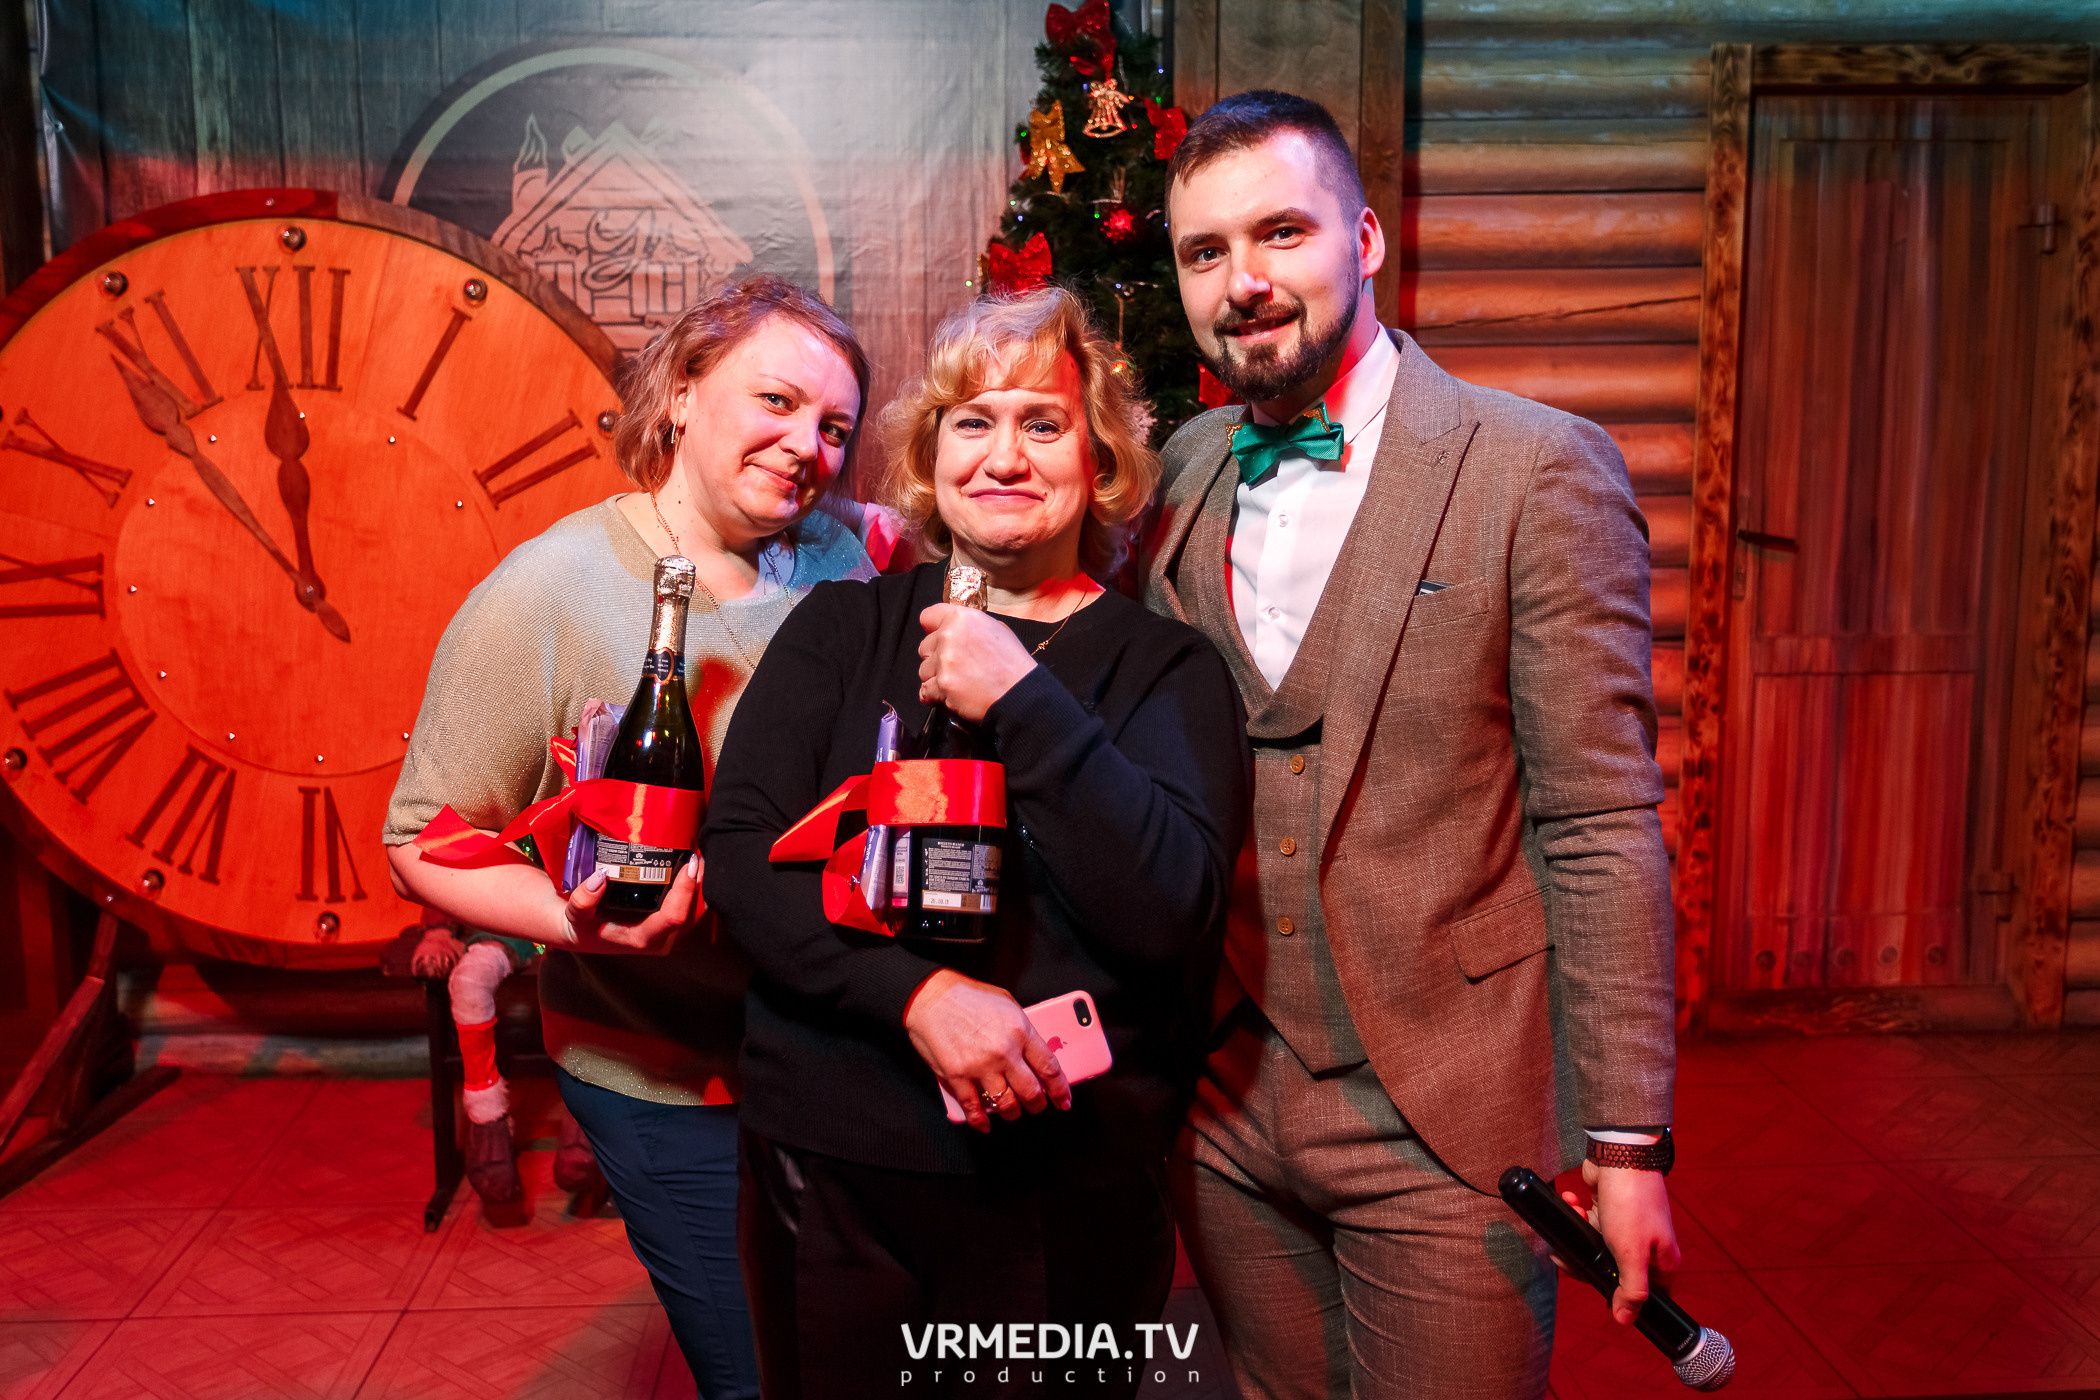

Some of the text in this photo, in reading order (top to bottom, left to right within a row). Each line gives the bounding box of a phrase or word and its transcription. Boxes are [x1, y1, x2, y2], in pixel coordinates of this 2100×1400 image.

[95, 290, 225, 420] XI
[236, 264, 351, 392] XII
[396, 306, 472, 421] I
[2, 405, 133, 509] X
[472, 408, 601, 511] II
[0, 553, 106, 619] IX
[4, 647, 157, 805] VIII
[125, 744, 237, 885] VII
[296, 785, 368, 903] VI
